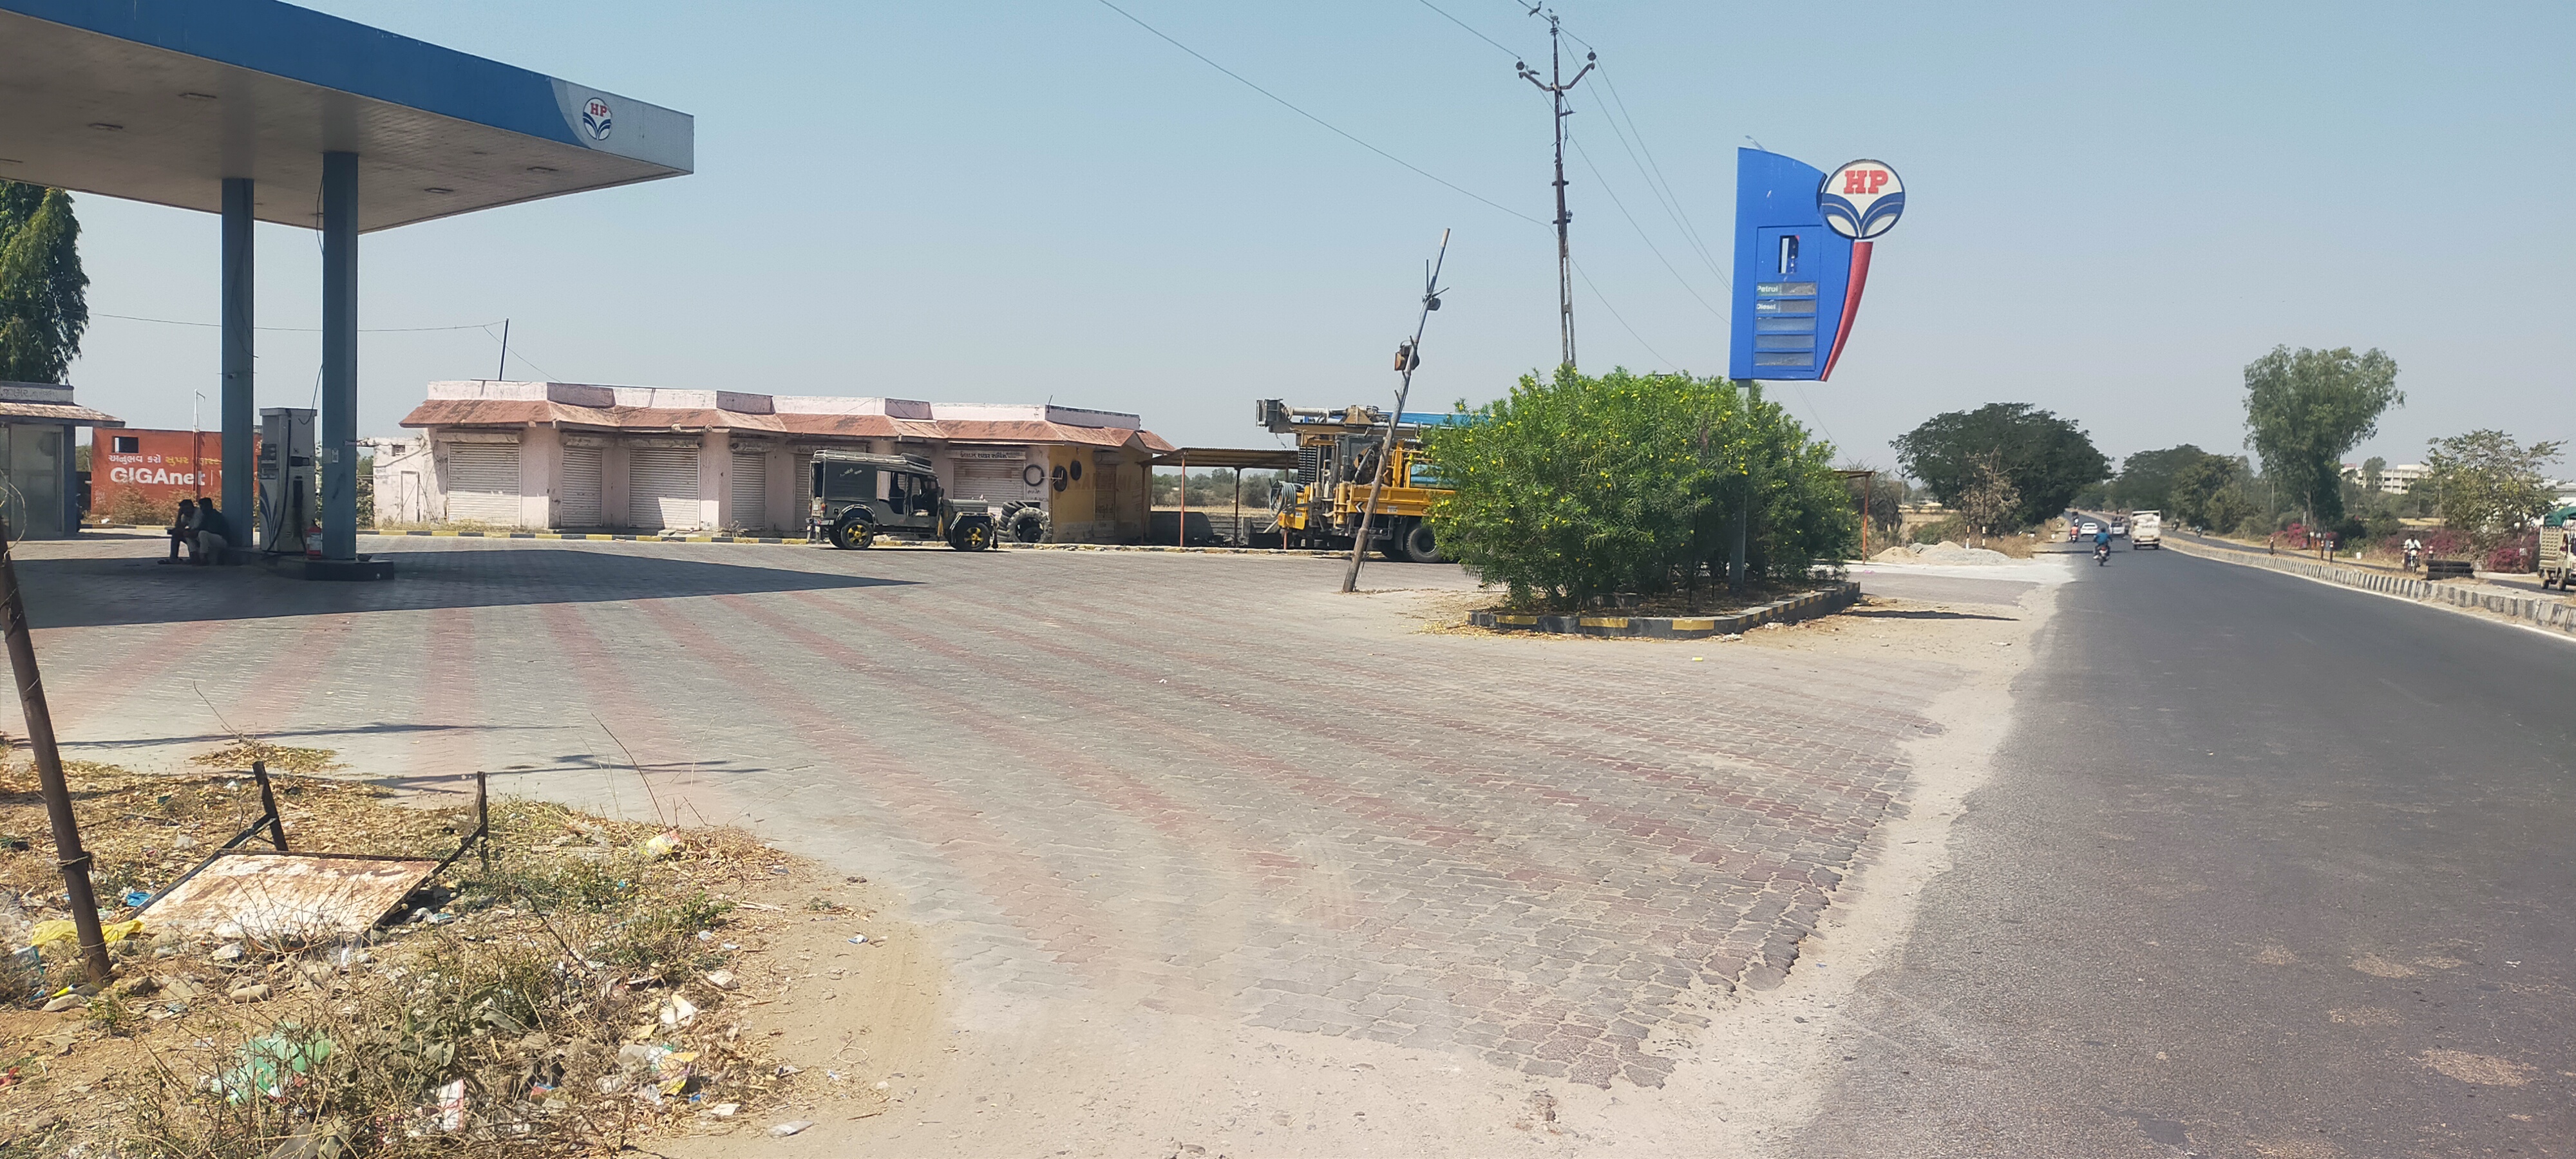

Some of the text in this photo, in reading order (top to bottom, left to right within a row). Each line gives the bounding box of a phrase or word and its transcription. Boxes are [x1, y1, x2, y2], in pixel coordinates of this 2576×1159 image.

[591, 102, 607, 117] HP
[1844, 170, 1888, 194] HP
[108, 455, 143, 464] અનુભવ
[147, 453, 161, 463] કરો
[165, 456, 189, 467] સુપર
[110, 467, 205, 485] GIGAnet
